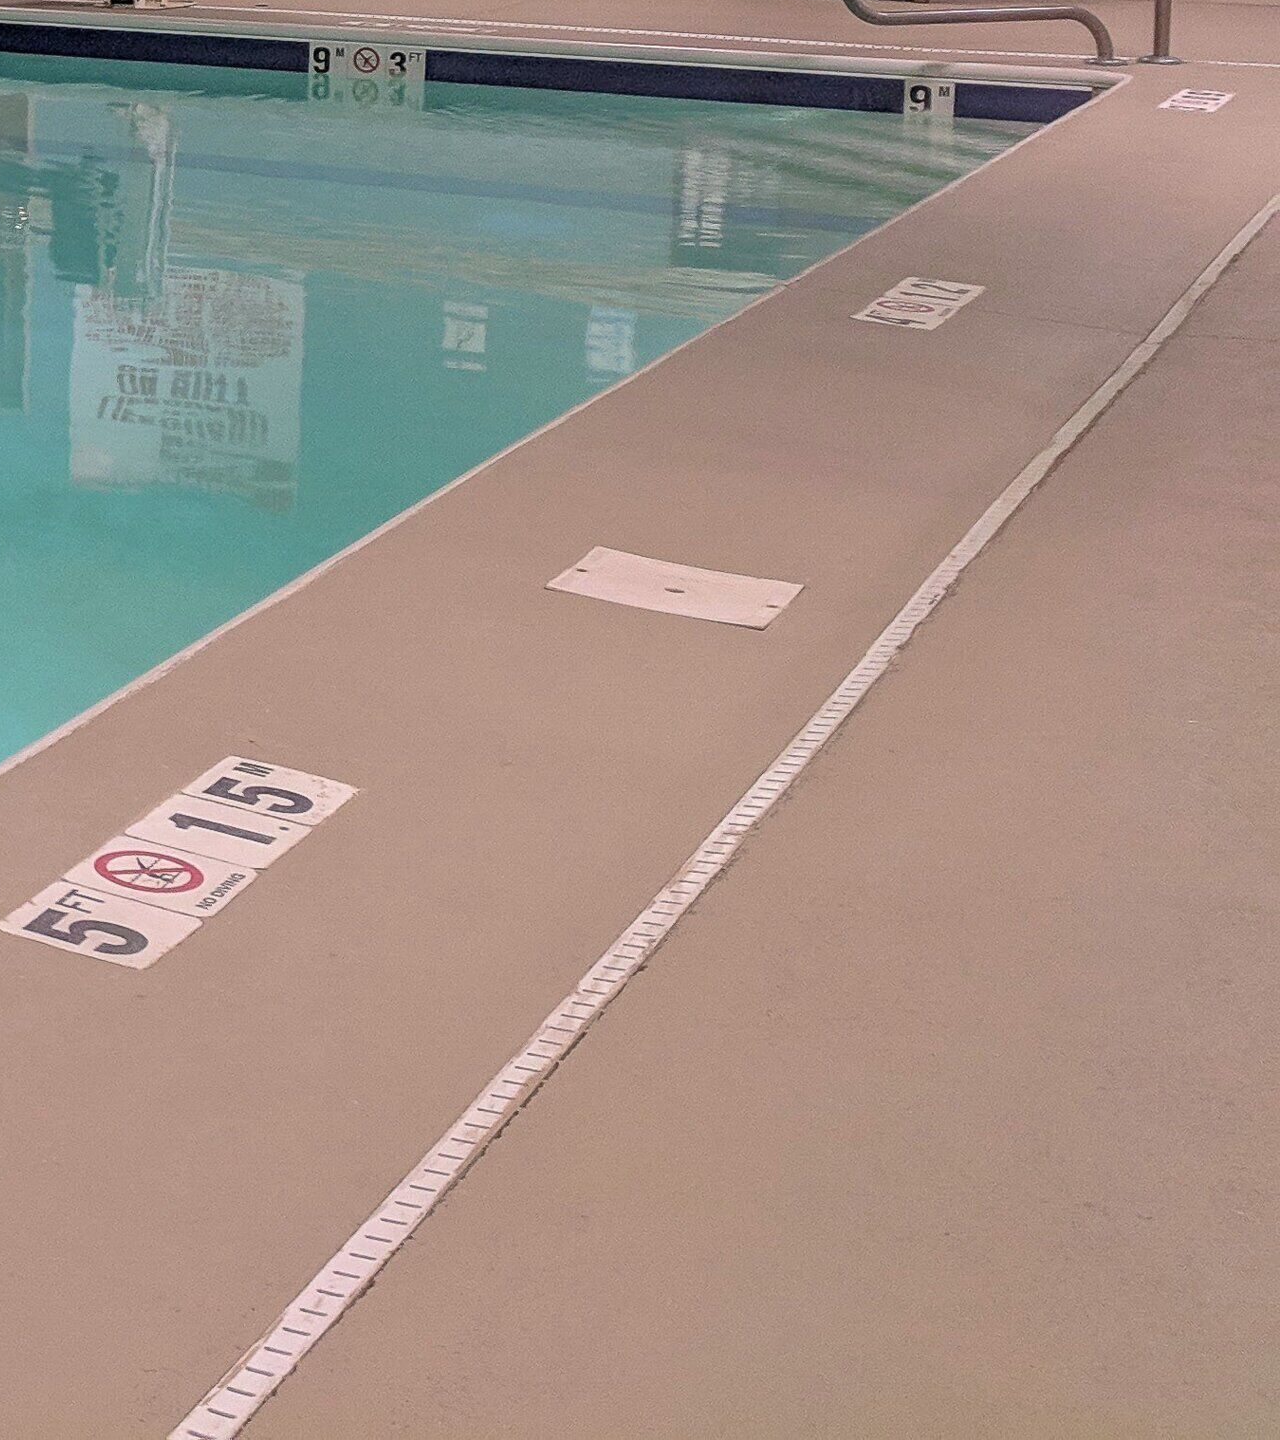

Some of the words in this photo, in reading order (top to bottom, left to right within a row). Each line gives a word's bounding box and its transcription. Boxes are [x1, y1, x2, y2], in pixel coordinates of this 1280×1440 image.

[313, 47, 330, 73] 9
[389, 52, 407, 76] 3
[910, 85, 931, 111] 9
[195, 897, 217, 910] NO
[210, 873, 246, 897] DIVING
[23, 908, 149, 955] 5
